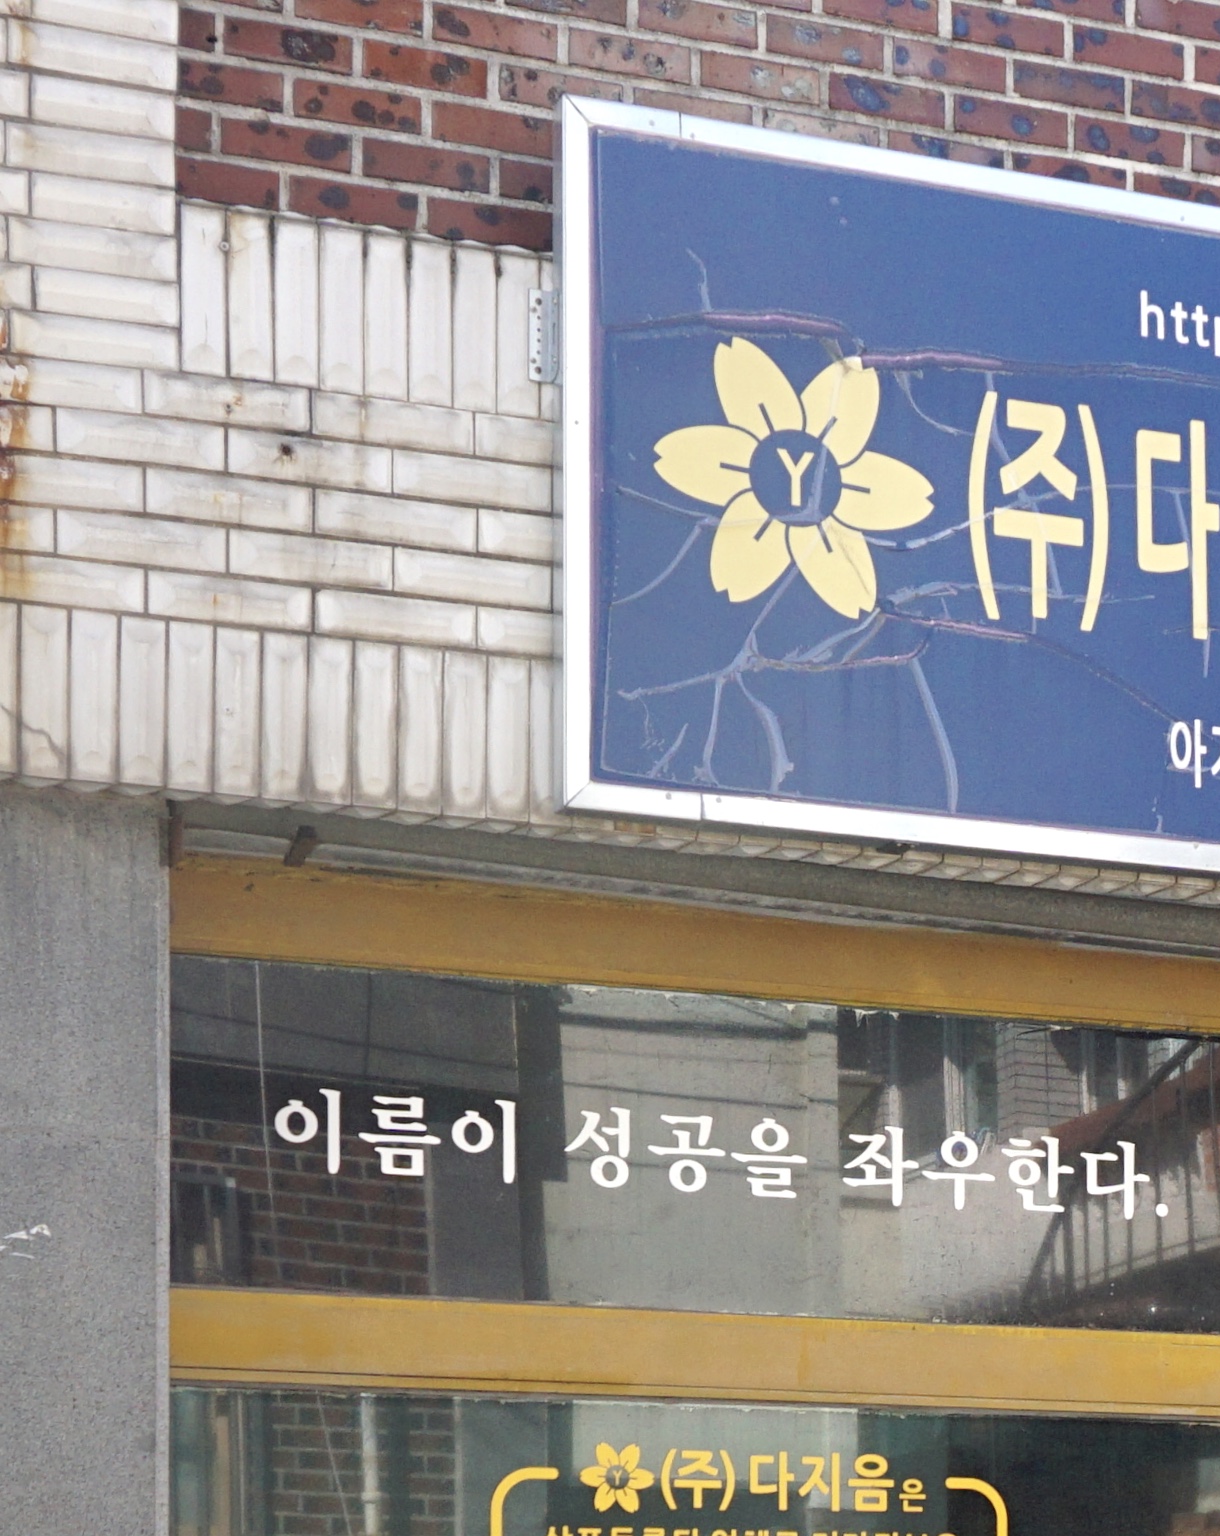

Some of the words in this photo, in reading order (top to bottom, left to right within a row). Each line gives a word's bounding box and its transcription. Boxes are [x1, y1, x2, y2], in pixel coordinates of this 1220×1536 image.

[275, 1088, 515, 1184] 이름이
[564, 1107, 808, 1199] 성공을
[842, 1125, 1169, 1220] 좌우한다.
